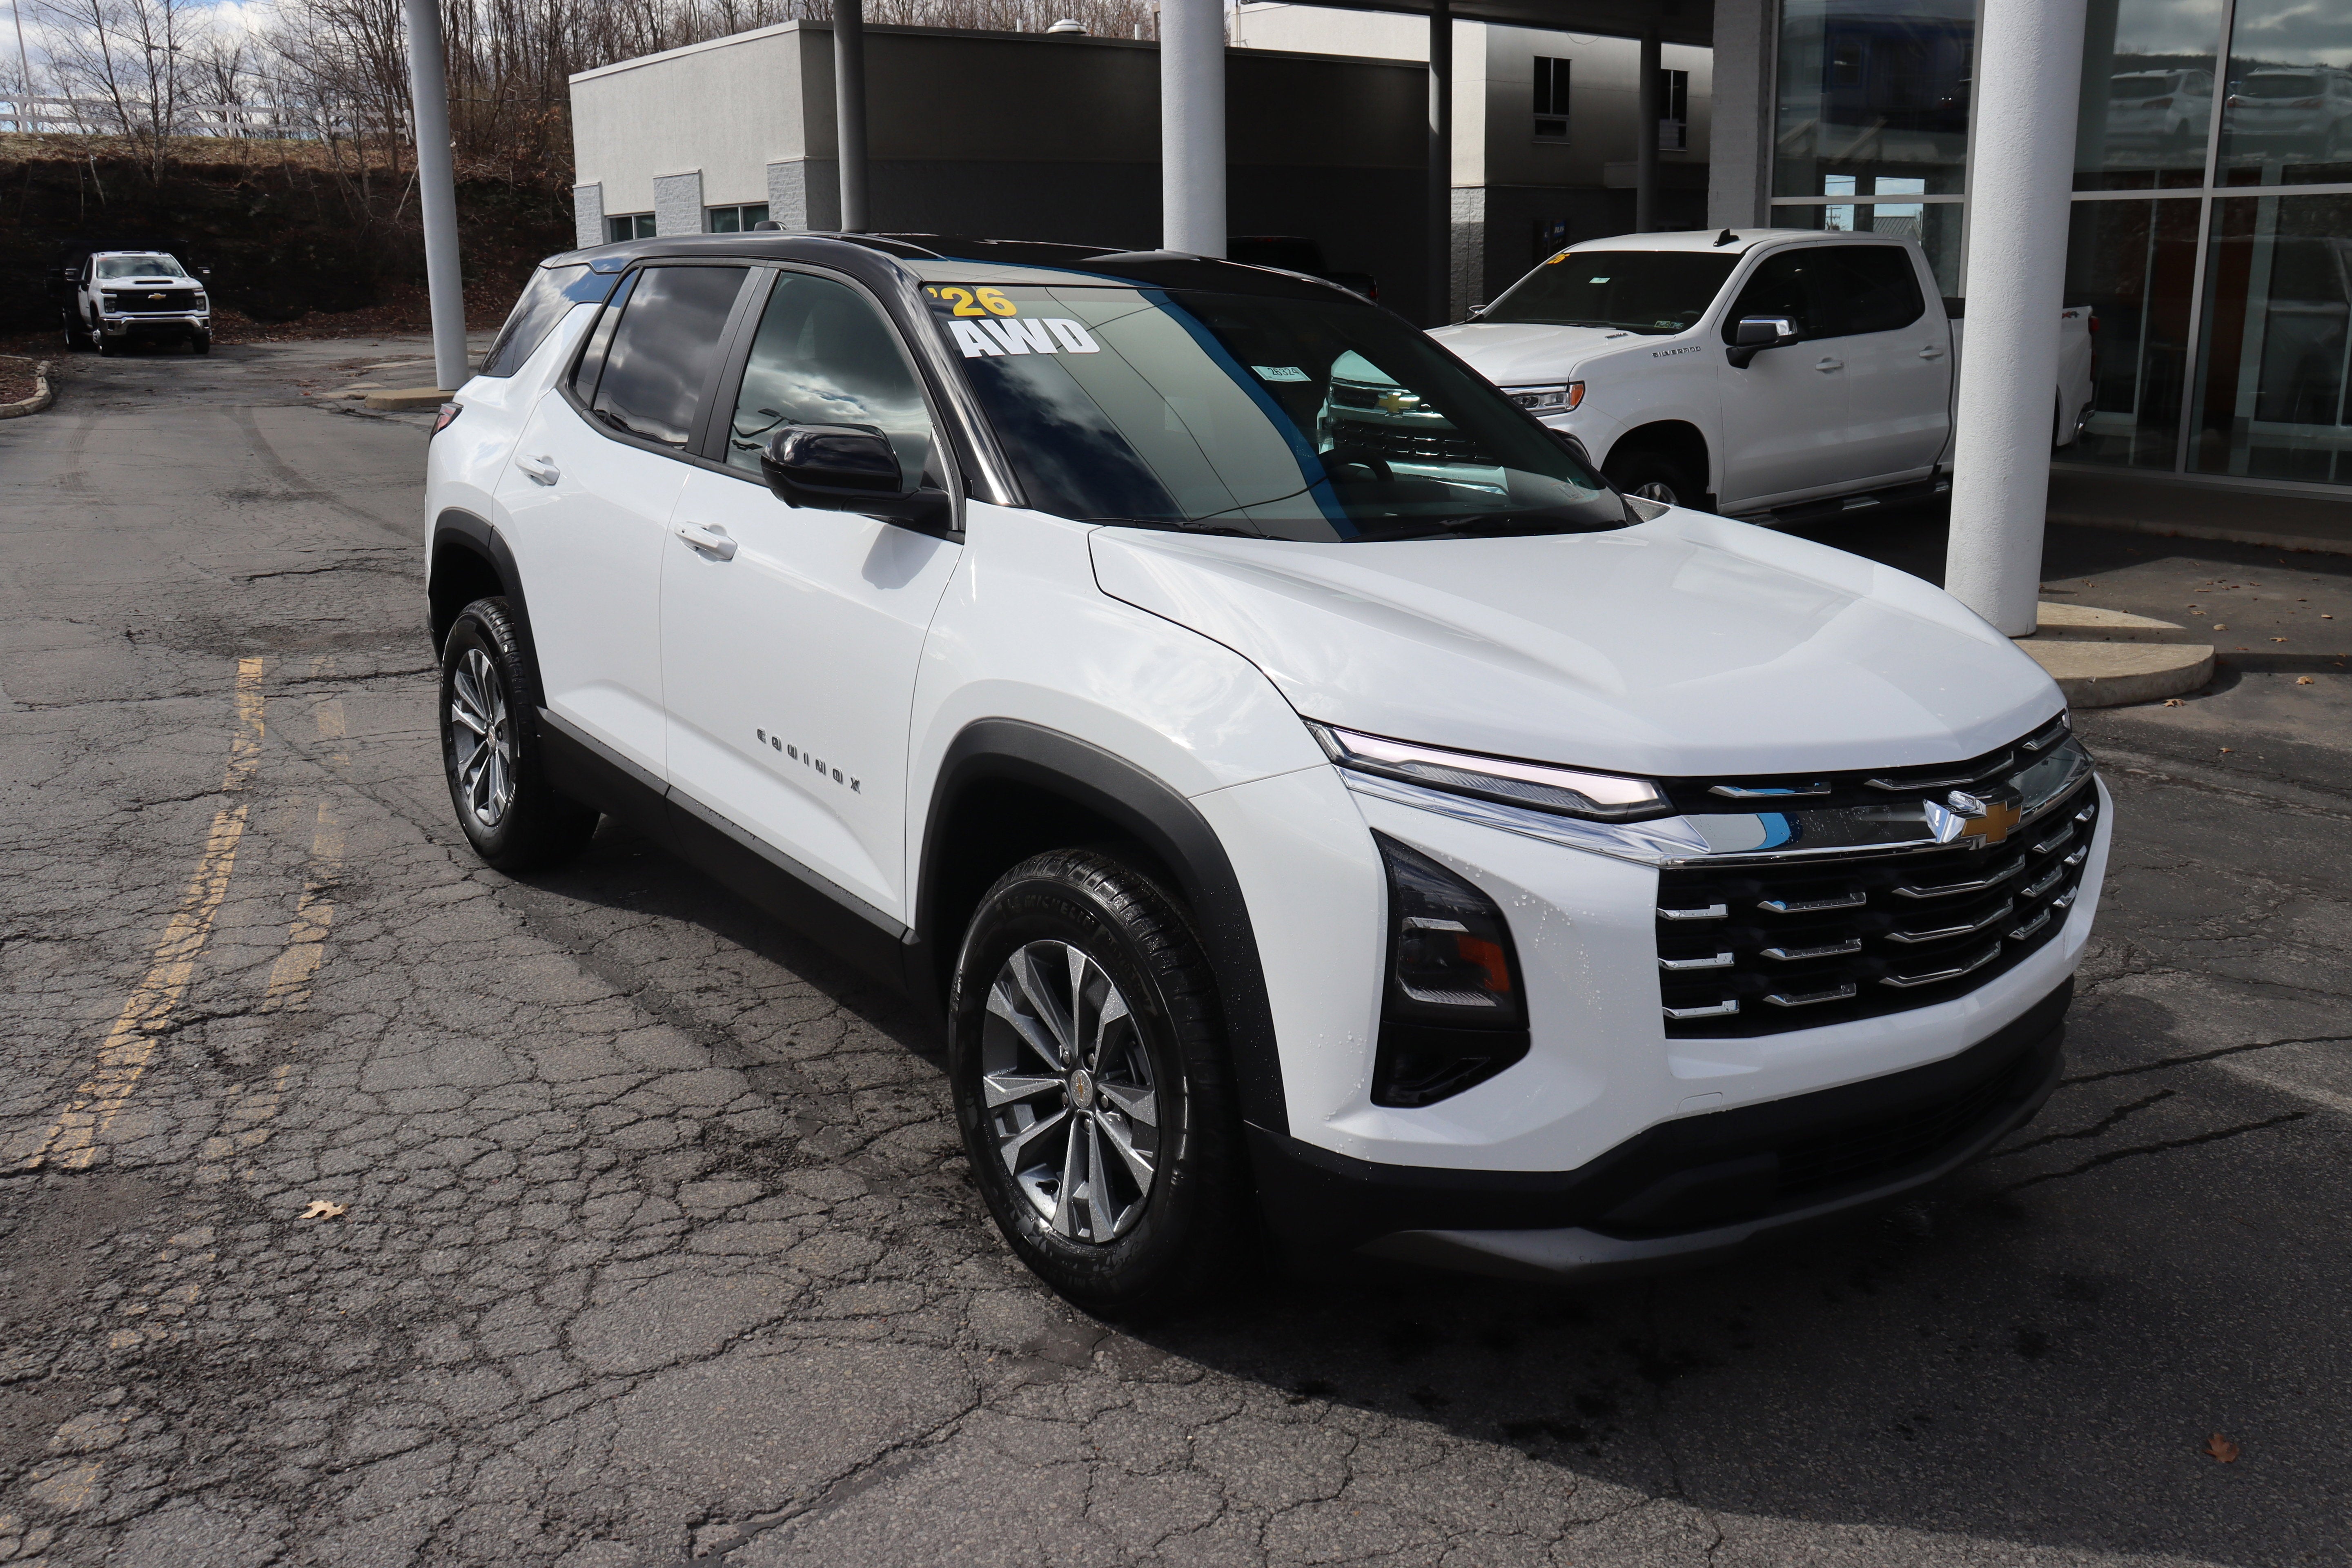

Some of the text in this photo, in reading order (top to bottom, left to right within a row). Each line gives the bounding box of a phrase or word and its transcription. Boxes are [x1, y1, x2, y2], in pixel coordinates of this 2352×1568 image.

[927, 287, 1017, 316] '26
[947, 318, 1100, 358] AWD
[1652, 346, 1701, 358] SILVERADO
[1267, 368, 1299, 376] 26324
[757, 728, 861, 793] EQUINOX
